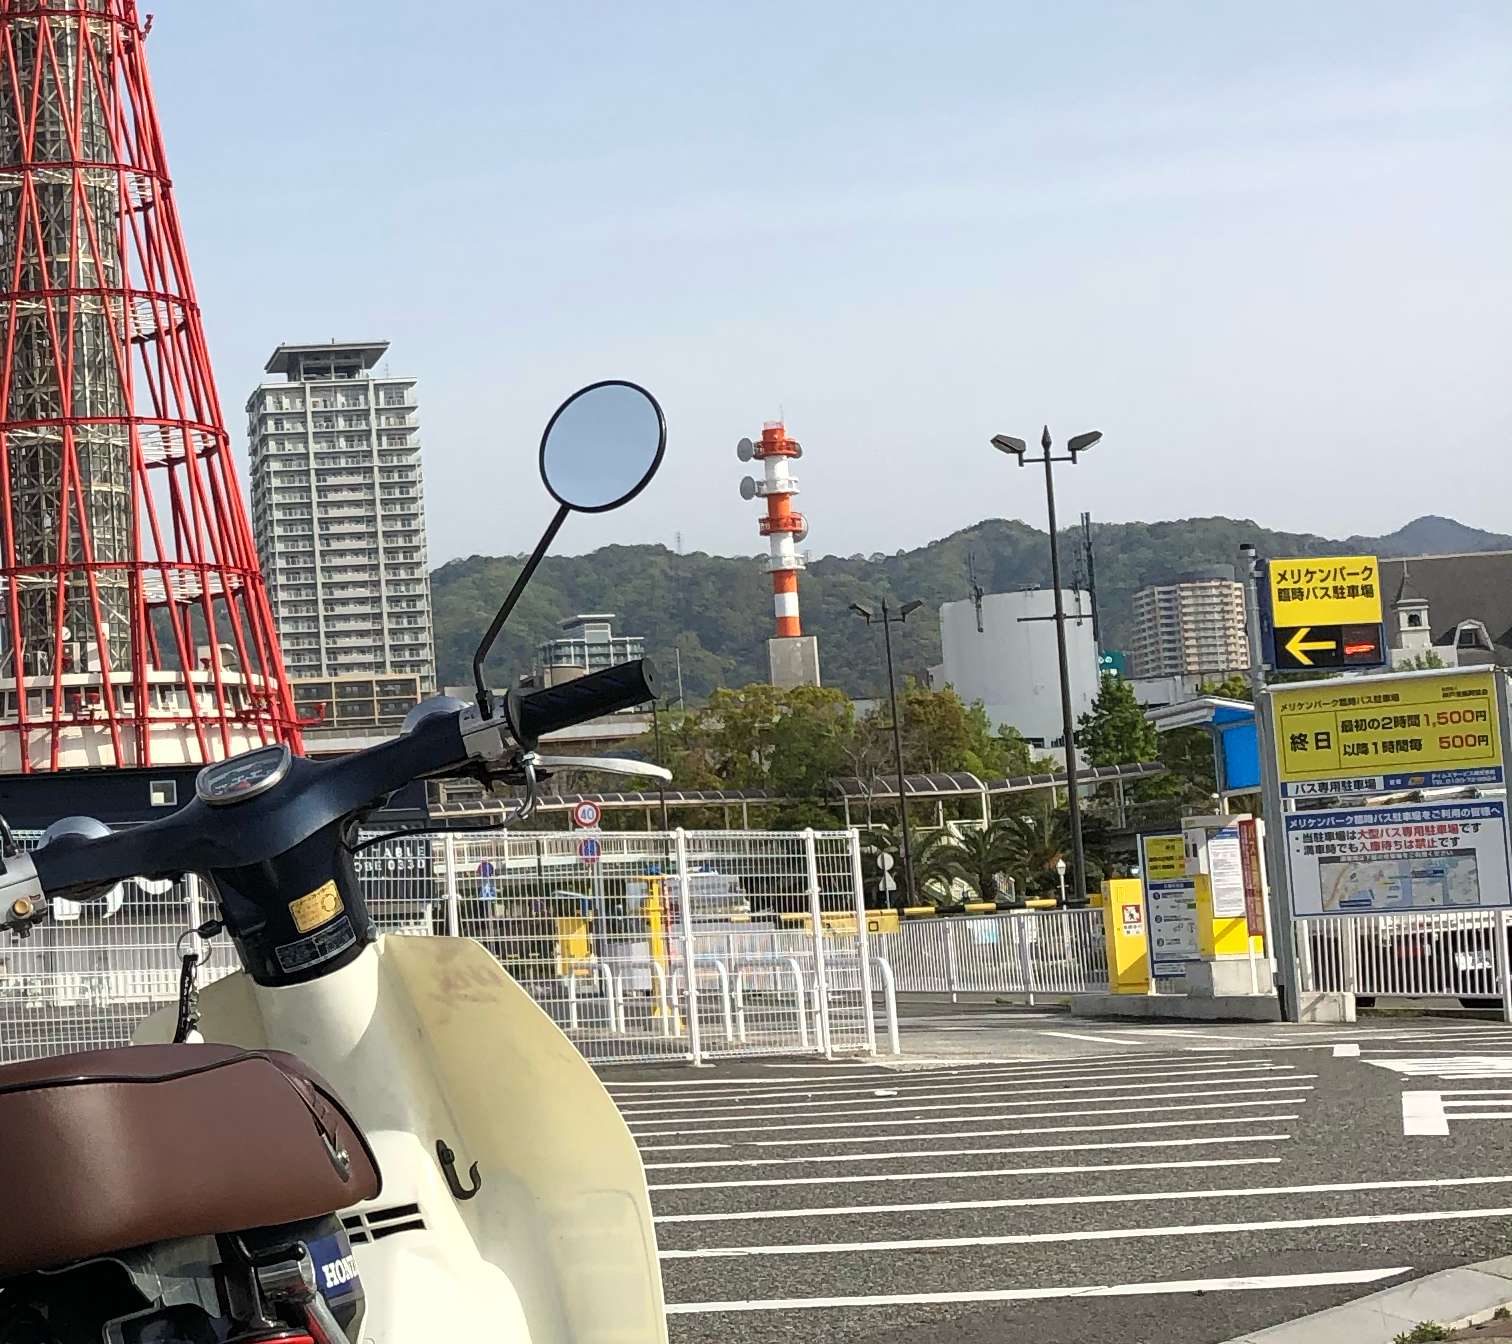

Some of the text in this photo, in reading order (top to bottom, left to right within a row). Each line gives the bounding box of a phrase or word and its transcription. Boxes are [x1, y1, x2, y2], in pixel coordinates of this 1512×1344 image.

[1276, 565, 1374, 585] メリケンパーク
[1277, 584, 1375, 603] 臨時バス駐車場
[1423, 709, 1487, 729] 1,500円
[1438, 733, 1489, 750] 500円
[1295, 777, 1377, 795] バス専用駐車場
[580, 807, 595, 820] 40
